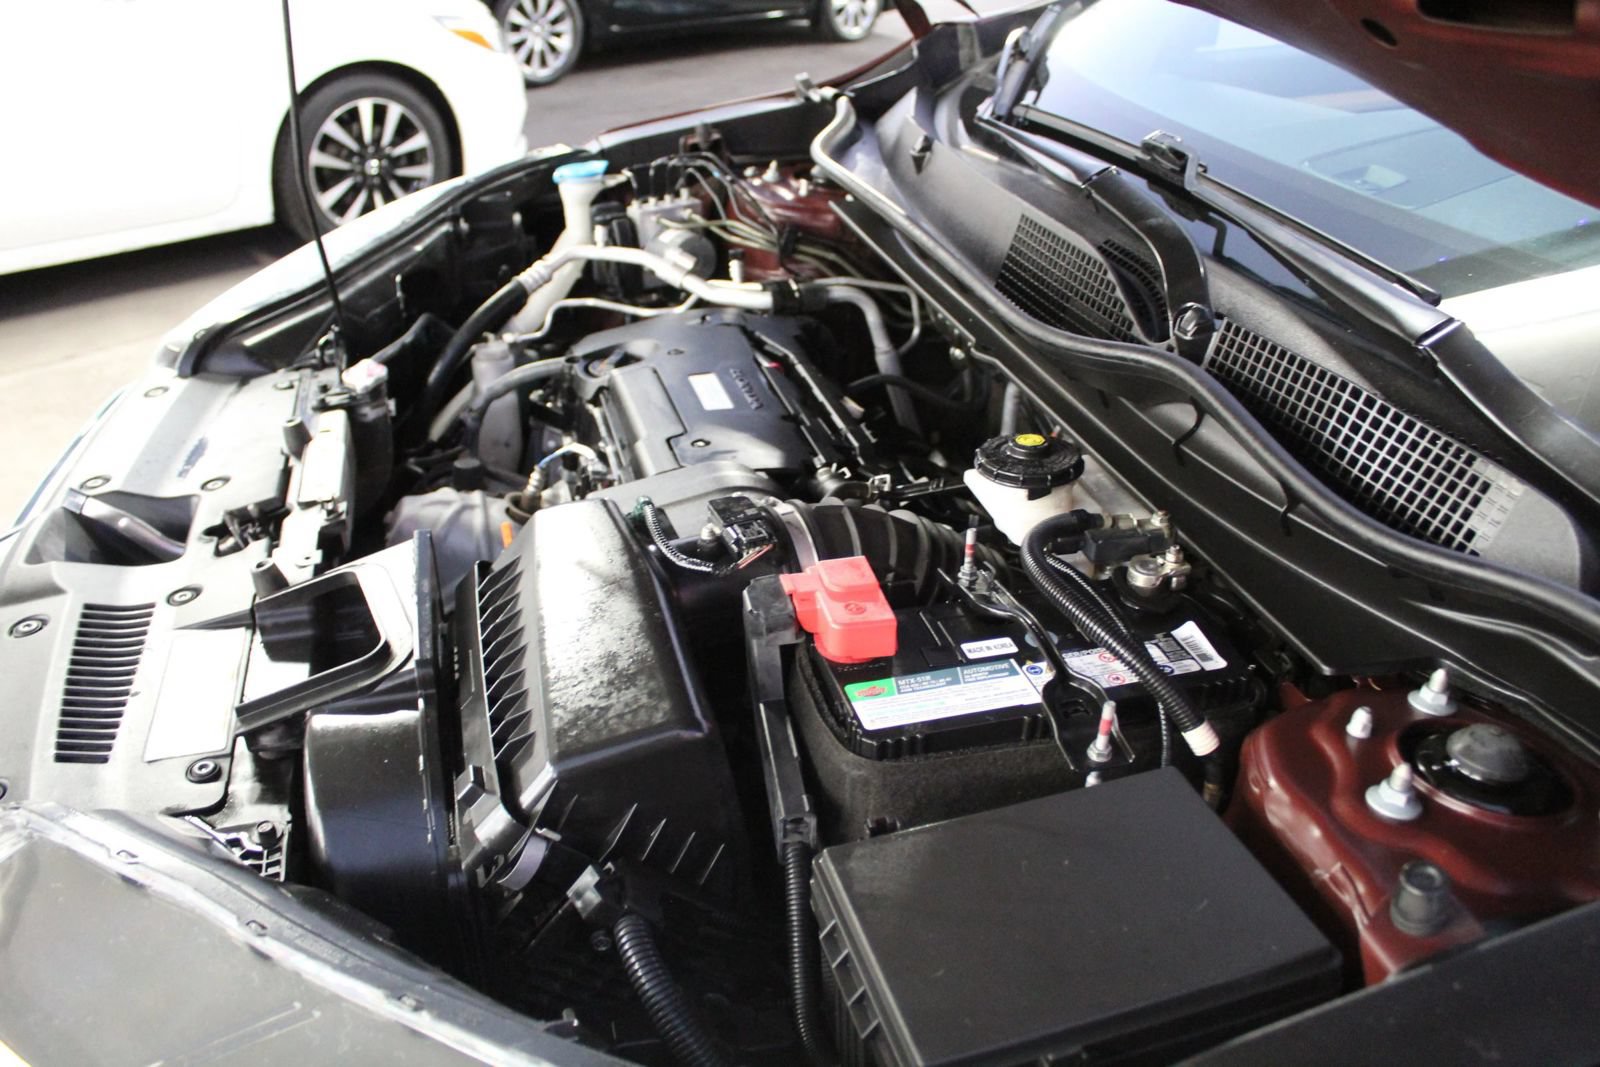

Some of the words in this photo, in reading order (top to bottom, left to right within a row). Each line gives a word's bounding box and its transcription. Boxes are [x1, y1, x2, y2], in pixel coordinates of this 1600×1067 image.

[966, 646, 985, 654] MADE
[993, 642, 1013, 651] KOREA
[963, 662, 1010, 674] AUTOMOTIVE
